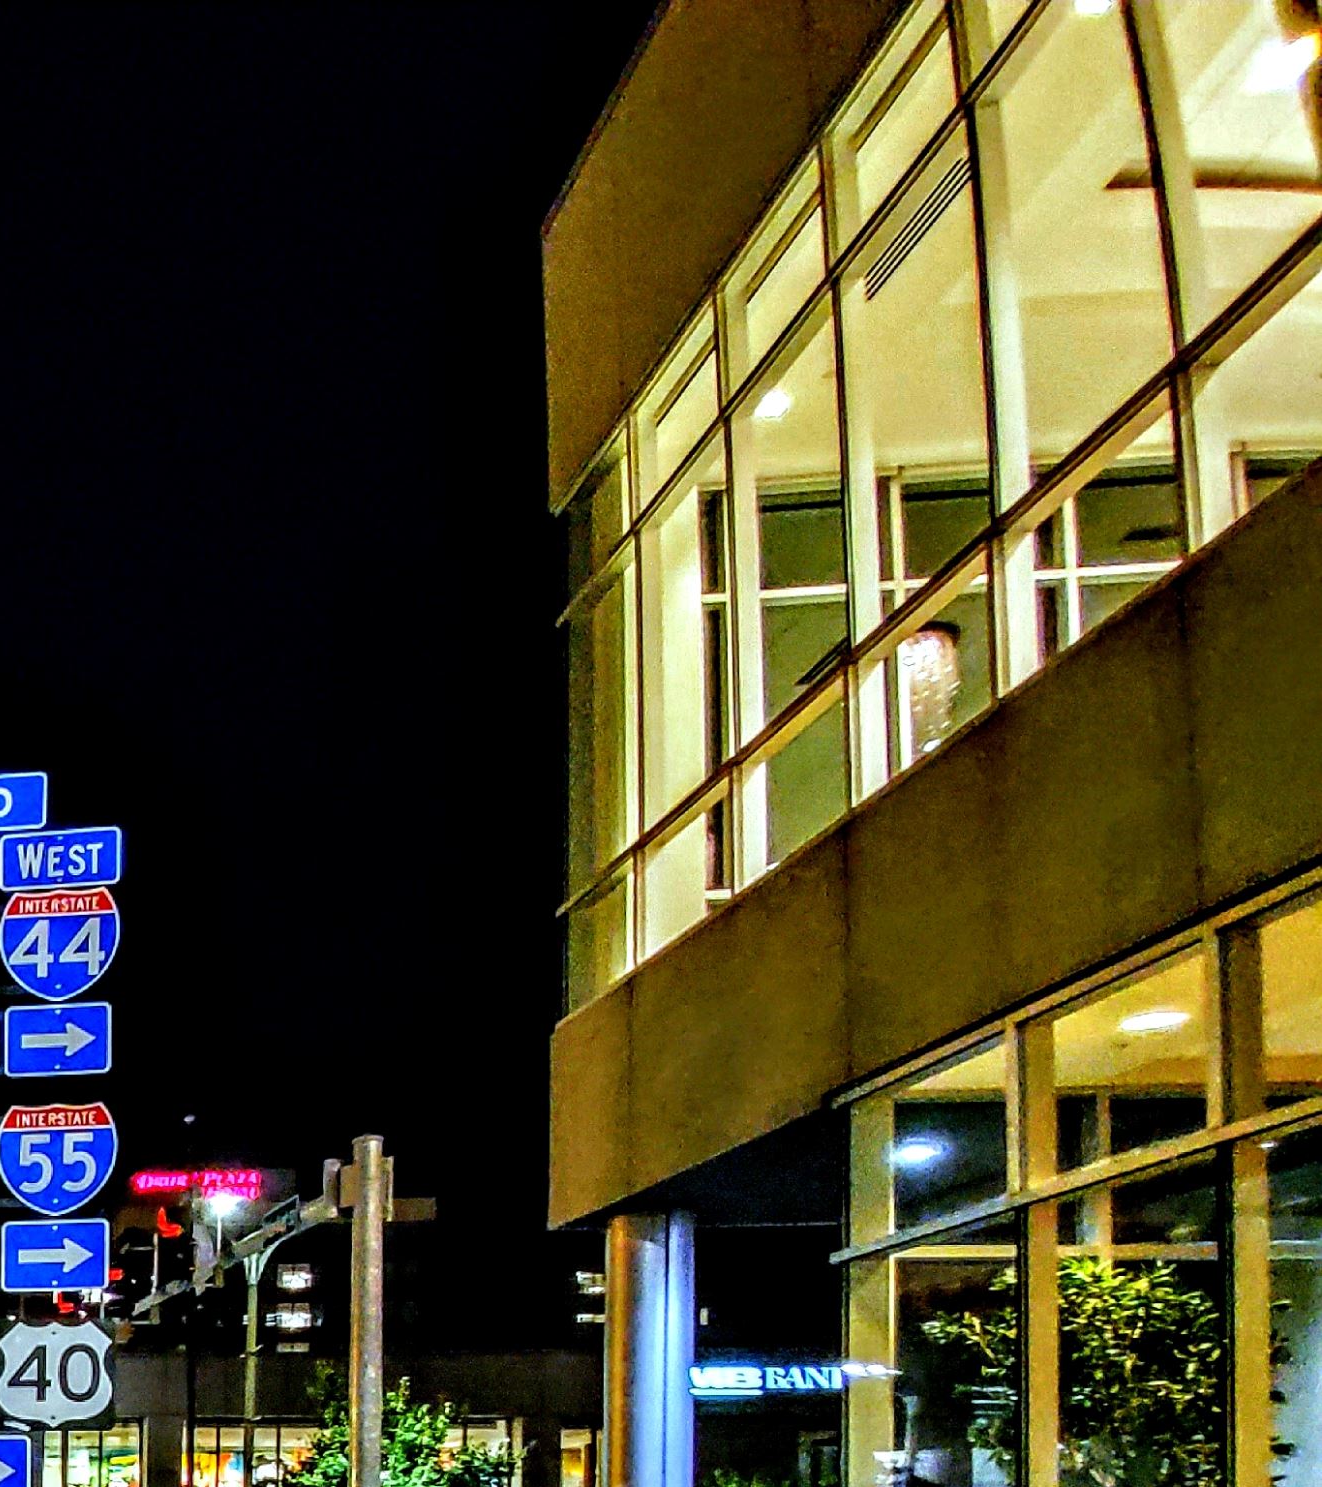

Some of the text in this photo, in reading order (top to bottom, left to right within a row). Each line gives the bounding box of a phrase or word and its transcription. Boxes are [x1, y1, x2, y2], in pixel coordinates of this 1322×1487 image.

[16, 842, 104, 880] WEST
[19, 896, 100, 914] INTERSTATE
[8, 917, 106, 979] 44
[15, 1110, 98, 1127] INTERSTATE
[17, 1132, 97, 1194] 55
[6, 1342, 101, 1403] 40
